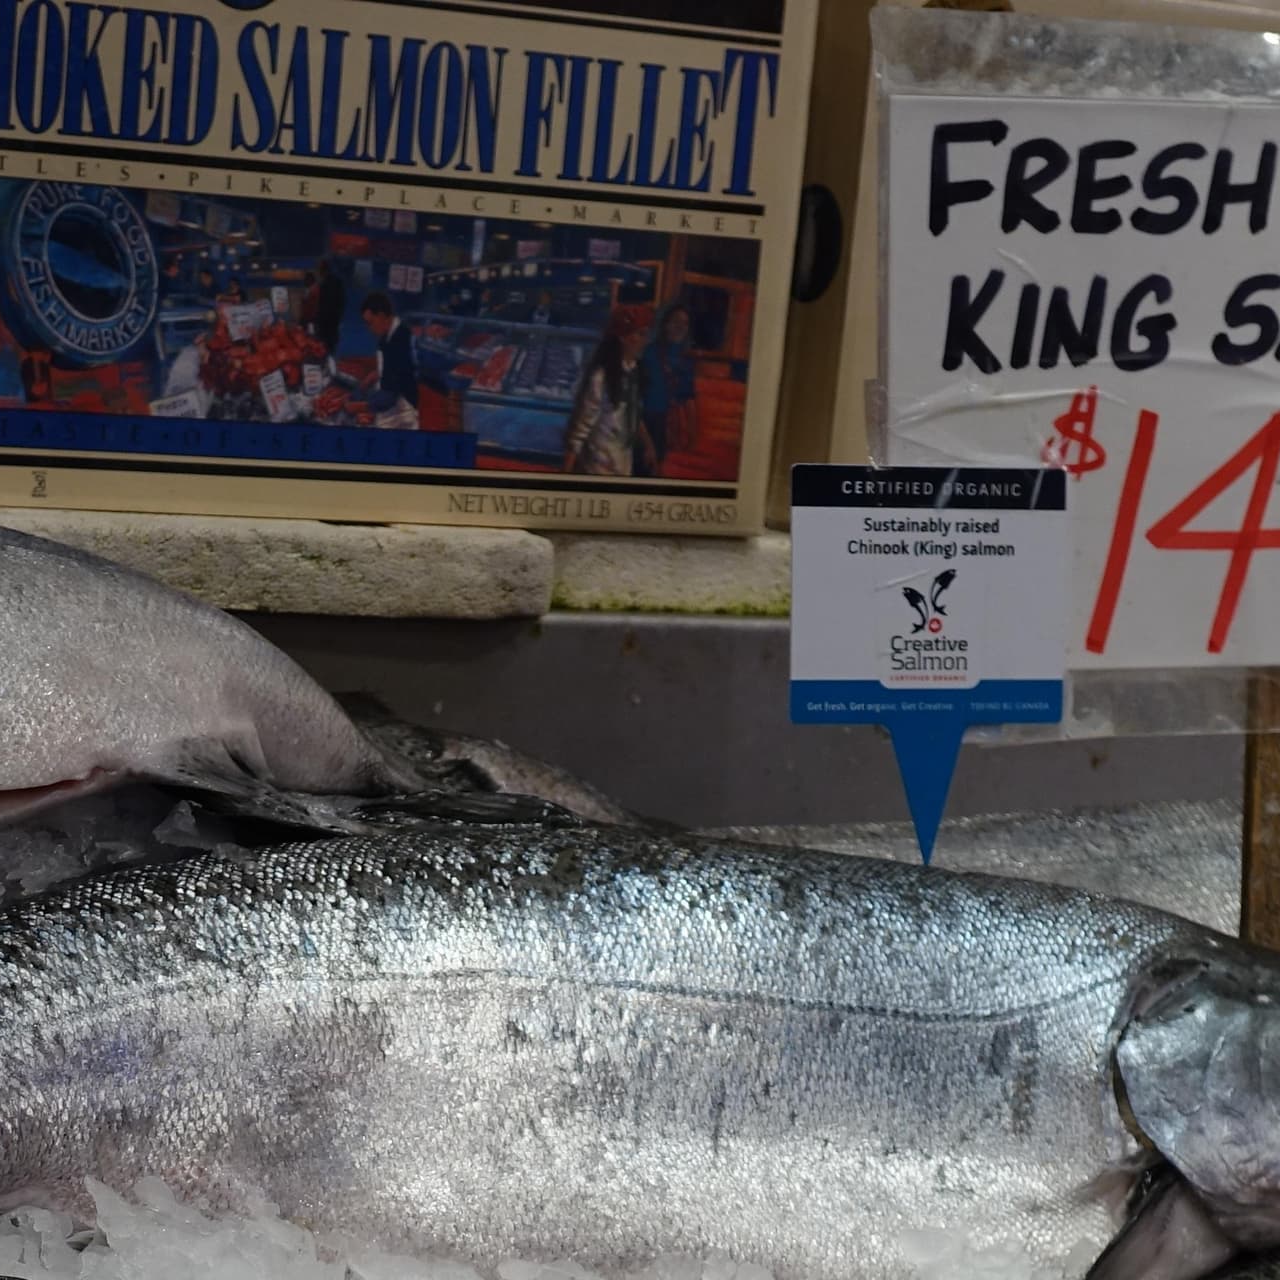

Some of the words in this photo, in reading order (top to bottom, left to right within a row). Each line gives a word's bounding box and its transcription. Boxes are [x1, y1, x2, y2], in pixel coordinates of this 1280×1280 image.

[231, 20, 508, 173] SALMON
[514, 47, 780, 196] FILLET
[927, 118, 1279, 237] FRESH
[187, 171, 311, 197] PIKE
[364, 187, 520, 215] PLACE
[573, 205, 760, 235] MARKET
[939, 270, 1177, 374] KING
[840, 480, 935, 496] CERTIFIED
[941, 482, 1022, 497] ORGANIC
[447, 493, 488, 514] NET
[492, 494, 571, 518] WEIGHT
[588, 499, 611, 519] LB
[863, 517, 952, 537] Sustainably
[955, 519, 1000, 534] raised
[847, 540, 910, 556] Chinook
[913, 541, 958, 560] (King)
[961, 542, 1016, 557] salmon
[890, 635, 969, 652] Creative
[890, 651, 969, 672] Salmon
